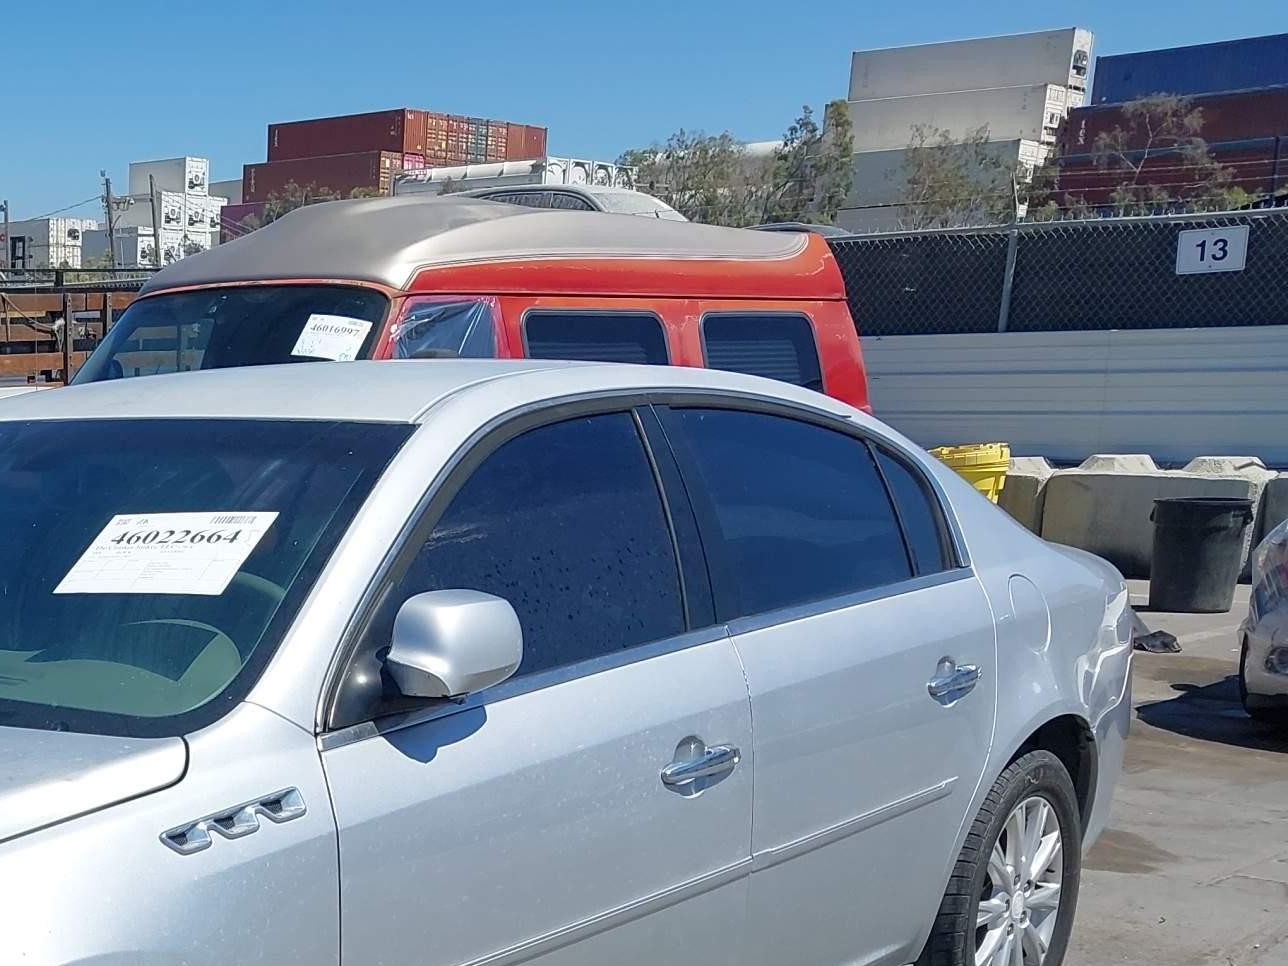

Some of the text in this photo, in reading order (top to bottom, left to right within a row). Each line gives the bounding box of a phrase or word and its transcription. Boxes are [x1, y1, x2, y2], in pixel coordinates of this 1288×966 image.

[1196, 238, 1229, 262] 13
[310, 323, 360, 337] 46016997
[111, 528, 242, 545] 46022664
